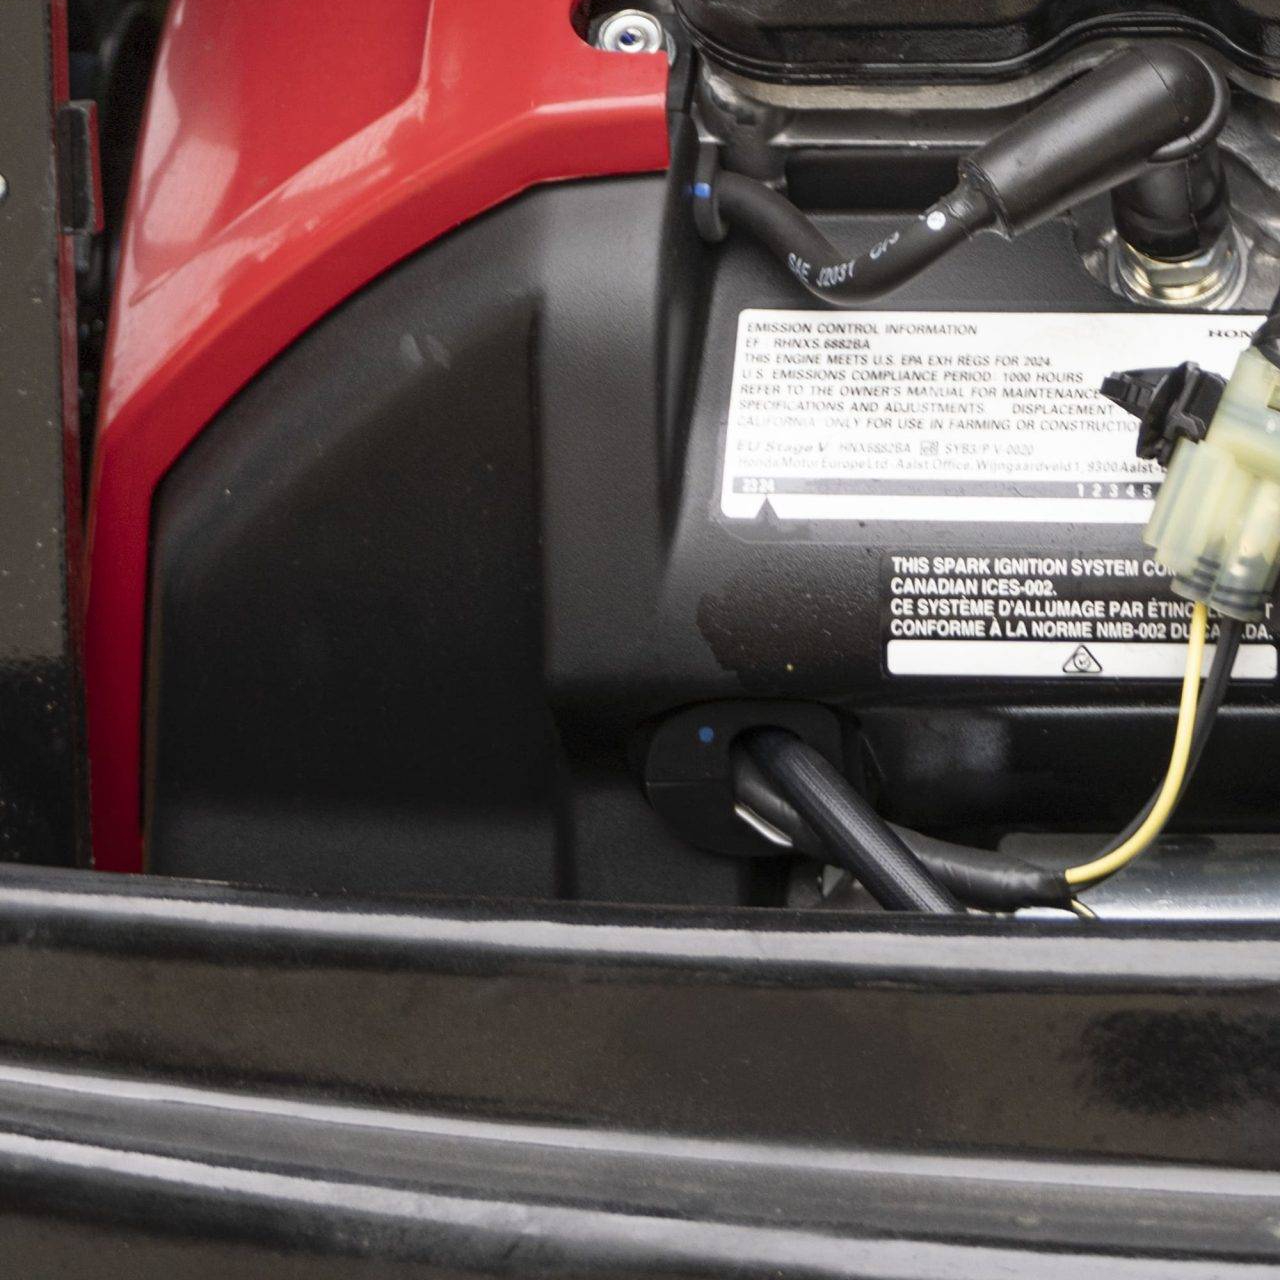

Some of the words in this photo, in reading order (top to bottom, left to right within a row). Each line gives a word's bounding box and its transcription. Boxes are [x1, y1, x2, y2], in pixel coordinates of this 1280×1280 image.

[747, 323, 812, 334] EMISSION
[816, 322, 879, 334] CONTROL
[884, 323, 978, 336] INFORMATION
[1208, 329, 1256, 338] HON
[744, 353, 771, 364] THIS
[776, 353, 822, 365] ENGINE
[826, 354, 868, 366] MEETS
[900, 354, 923, 366] EPA
[927, 355, 952, 367] EXH
[957, 355, 991, 367] REGS
[995, 355, 1020, 367] FOR
[772, 369, 847, 381] EMISSIONS
[851, 370, 938, 382] COMPLIANCE
[1003, 372, 1031, 383] 1000
[1035, 372, 1084, 384] HOURS
[740, 384, 781, 395] REFER
[787, 384, 804, 395] TO
[810, 385, 834, 396] THE
[839, 385, 902, 397] OWNER'S
[906, 386, 965, 398] MANUAL
[971, 387, 997, 398] FOR
[739, 400, 845, 412] SPECIFICATIONS
[851, 401, 879, 413] AND
[825, 418, 862, 429] ONLY
[866, 418, 893, 430] FOR
[898, 419, 925, 430] USE
[929, 419, 944, 430] IN
[949, 419, 1010, 431] FARMING
[1016, 419, 1035, 432] OR
[1040, 420, 1138, 433] CONSTRUCTIO
[764, 440, 814, 456] Stage
[1076, 482, 1085, 498] 1
[1091, 482, 1102, 498] 2
[1109, 483, 1119, 498] 3
[1126, 484, 1136, 498] 4
[1142, 484, 1153, 499] 5
[891, 556, 930, 574] THIS
[932, 557, 991, 575] SPARK
[994, 558, 1068, 576] IGNITION
[1071, 559, 1138, 577] SYSTEM
[890, 577, 979, 596] CANADIAN
[981, 579, 1058, 597] ICES-002.
[890, 598, 914, 616] CE
[917, 594, 995, 617] SYSTÈME
[998, 600, 1105, 618] D'ALLUMAGE
[1109, 601, 1144, 618] PAR
[890, 619, 986, 637] CONFORME
[989, 616, 1002, 638] À
[1006, 620, 1028, 638] LA
[1031, 621, 1093, 639] NORME
[1096, 622, 1166, 640] NMB-002
